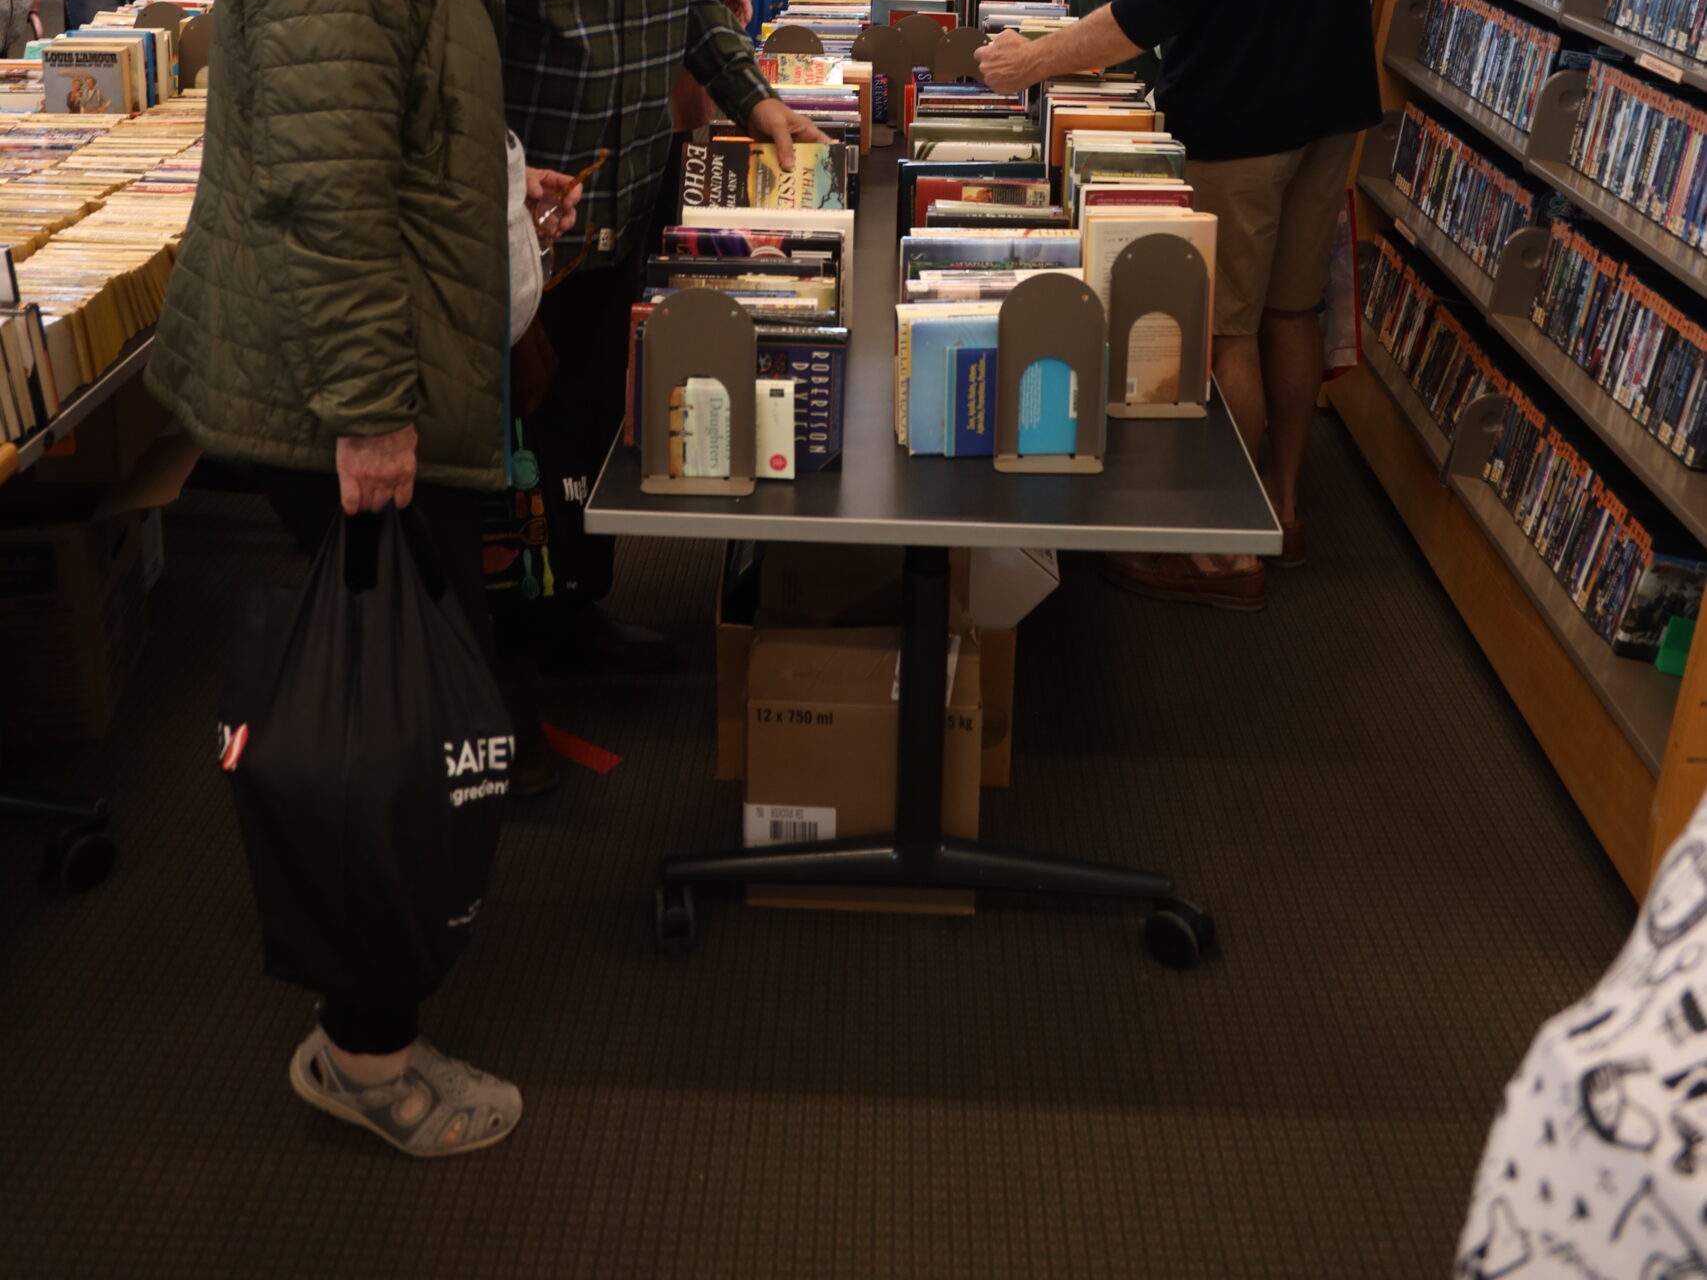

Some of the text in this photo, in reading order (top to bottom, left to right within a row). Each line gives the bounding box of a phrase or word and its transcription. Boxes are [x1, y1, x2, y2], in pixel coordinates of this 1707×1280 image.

[44, 52, 118, 64] LOUIS L'AMOUR
[683, 144, 708, 206] ECHO
[709, 153, 725, 208] MOUNTA
[727, 170, 738, 192] AND
[802, 167, 815, 208] KHAL
[809, 351, 830, 453] ROBERTSON
[705, 397, 723, 469] Daughters
[756, 708, 833, 725] 12 x 750 ml
[959, 715, 973, 731] kg
